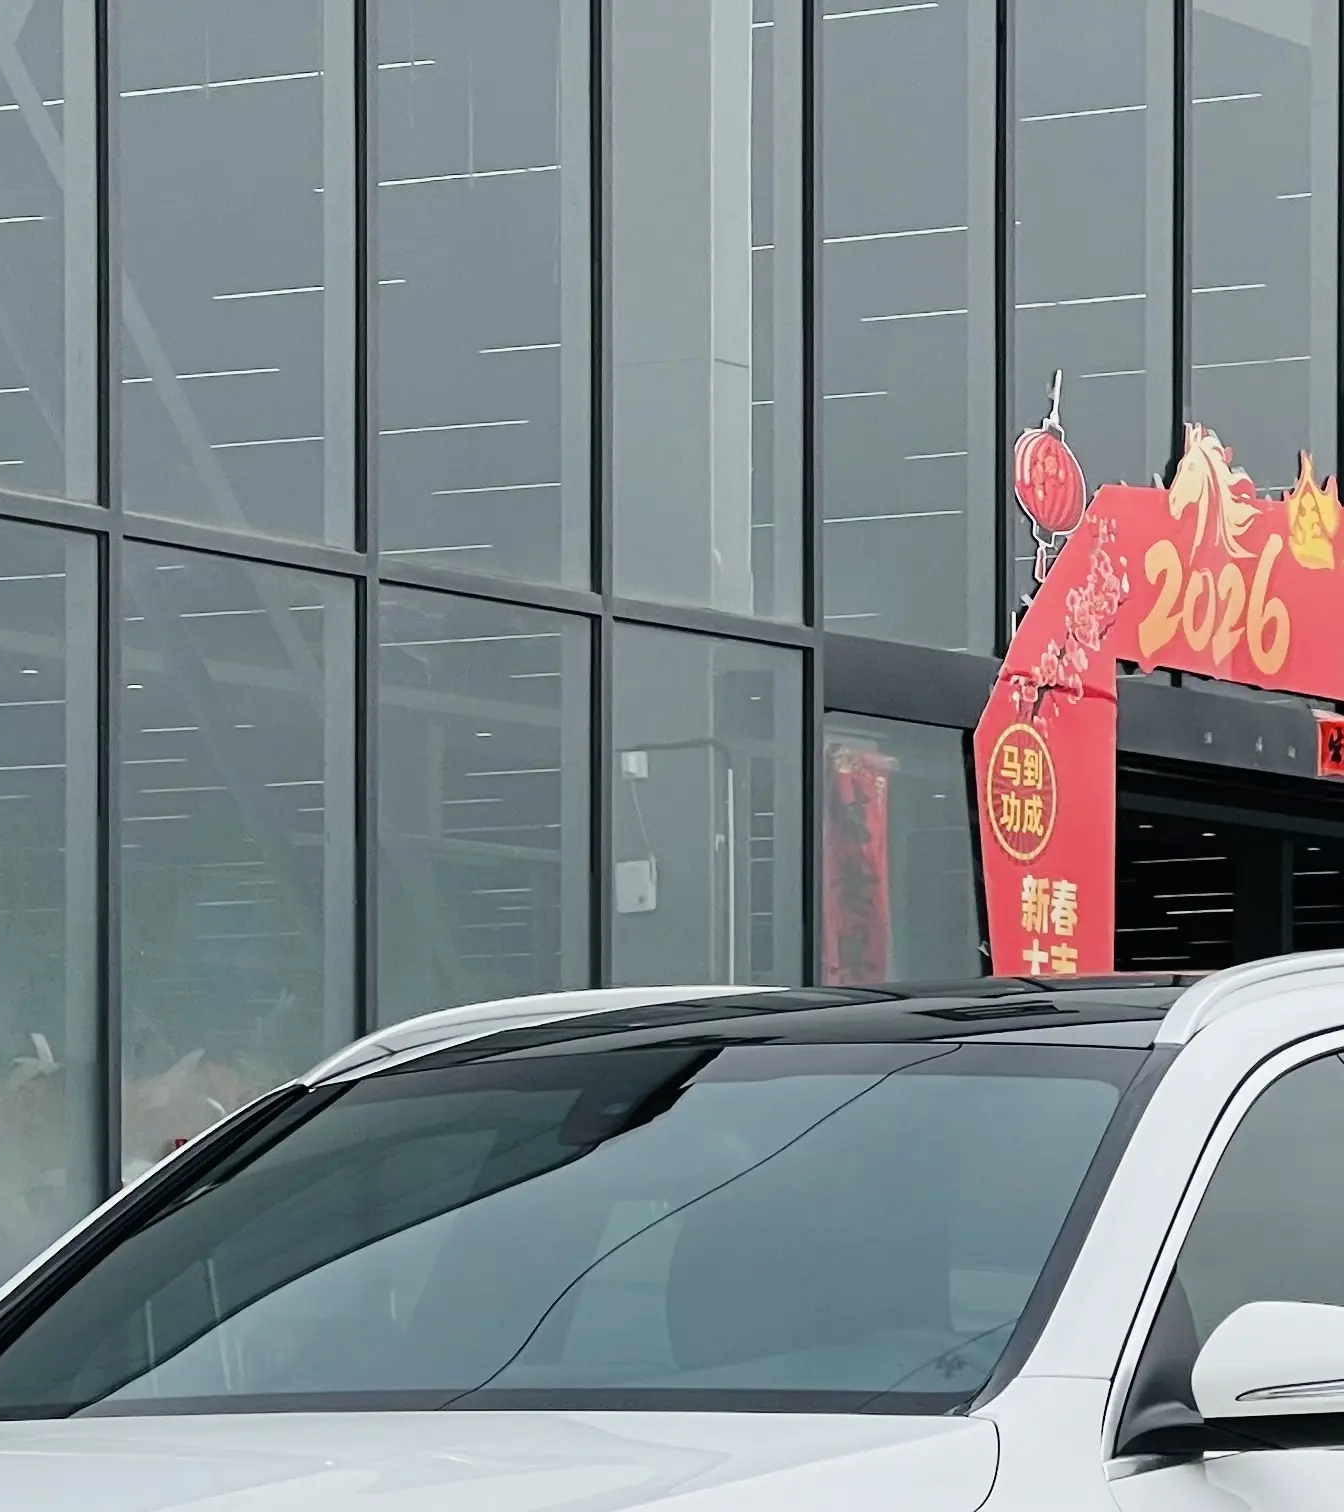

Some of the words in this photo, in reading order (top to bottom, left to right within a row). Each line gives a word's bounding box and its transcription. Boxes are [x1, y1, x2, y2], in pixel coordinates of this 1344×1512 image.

[1138, 533, 1291, 675] 2026
[1000, 744, 1043, 790] 马到
[1000, 791, 1044, 837] 功成
[1021, 874, 1078, 936] 新春
